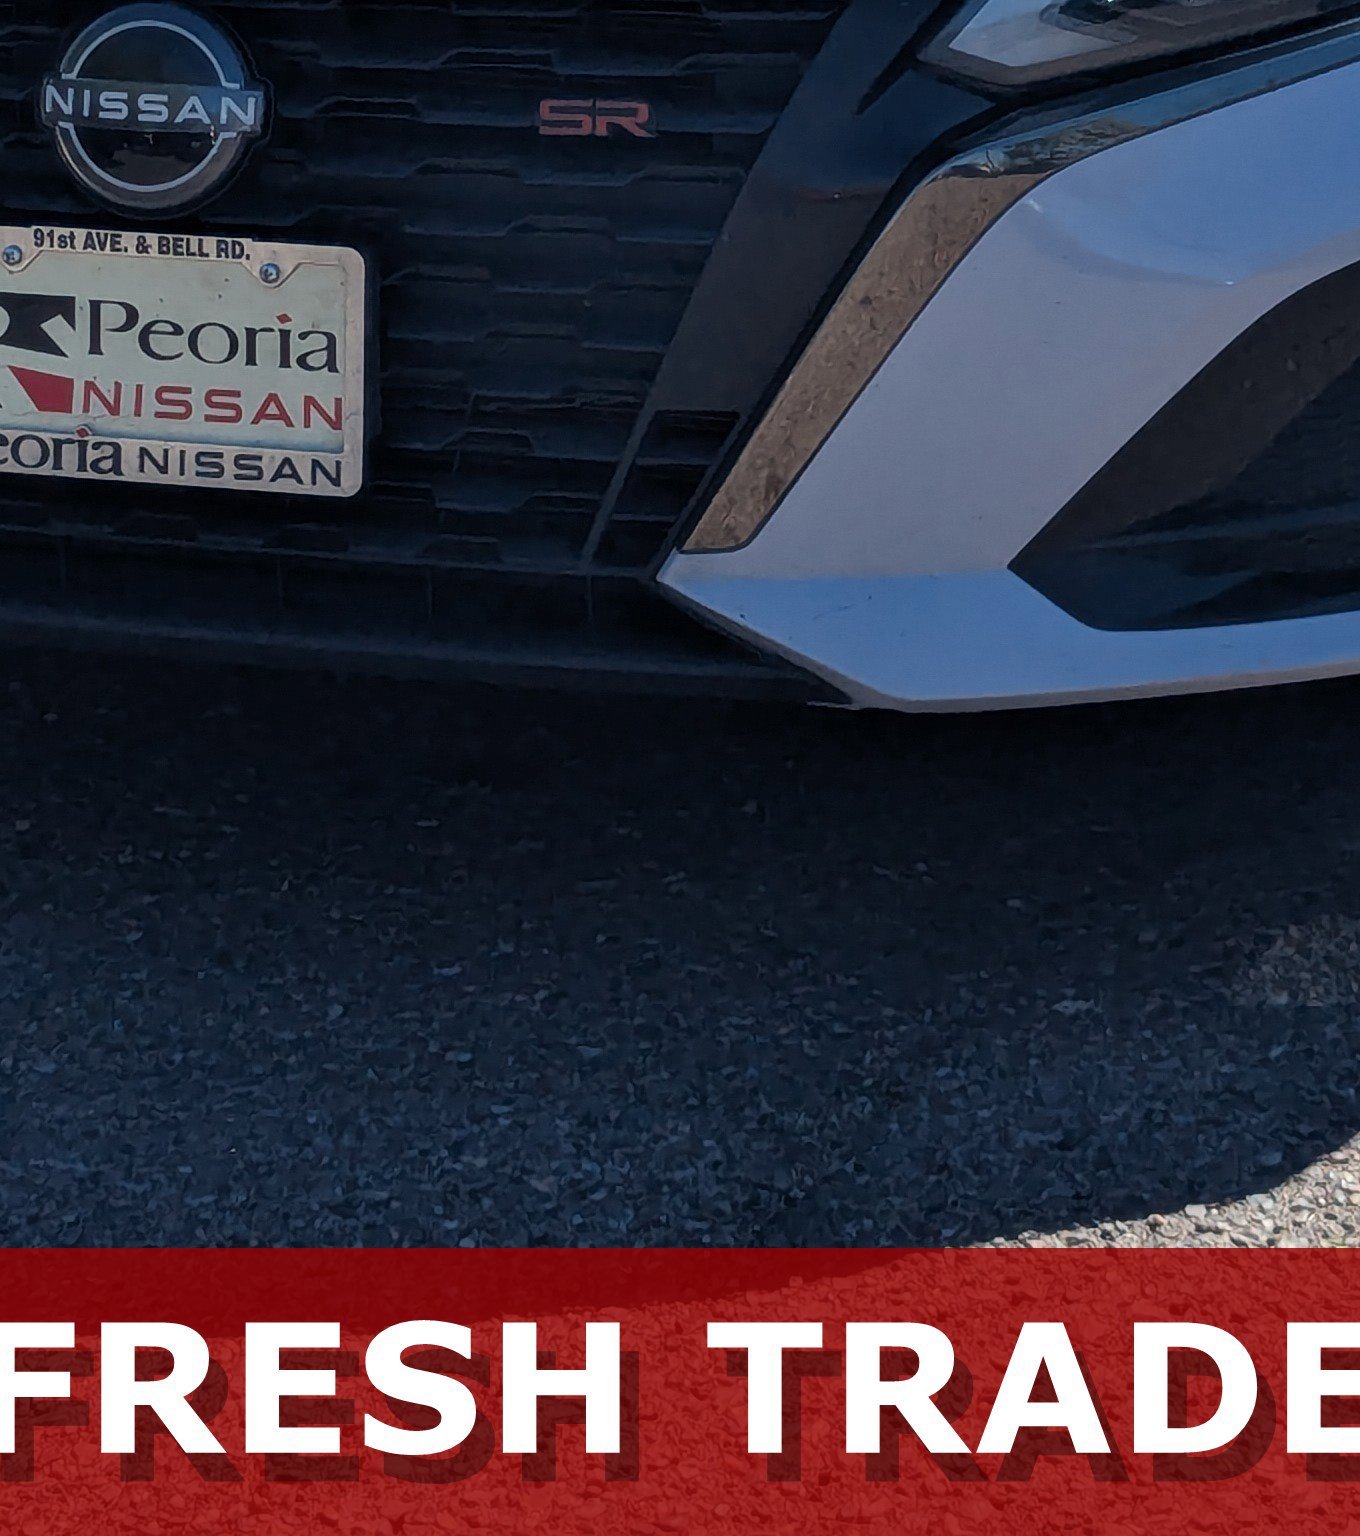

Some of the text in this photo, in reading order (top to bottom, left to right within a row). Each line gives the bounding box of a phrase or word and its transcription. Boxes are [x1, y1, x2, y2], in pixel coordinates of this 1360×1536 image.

[45, 86, 257, 127] NISSAN
[538, 98, 656, 138] SR
[33, 228, 251, 261] 91st AVE. & BELL RD.
[87, 299, 340, 374] Peoria
[82, 379, 344, 431] NISSAN
[138, 445, 342, 487] NISSAN
